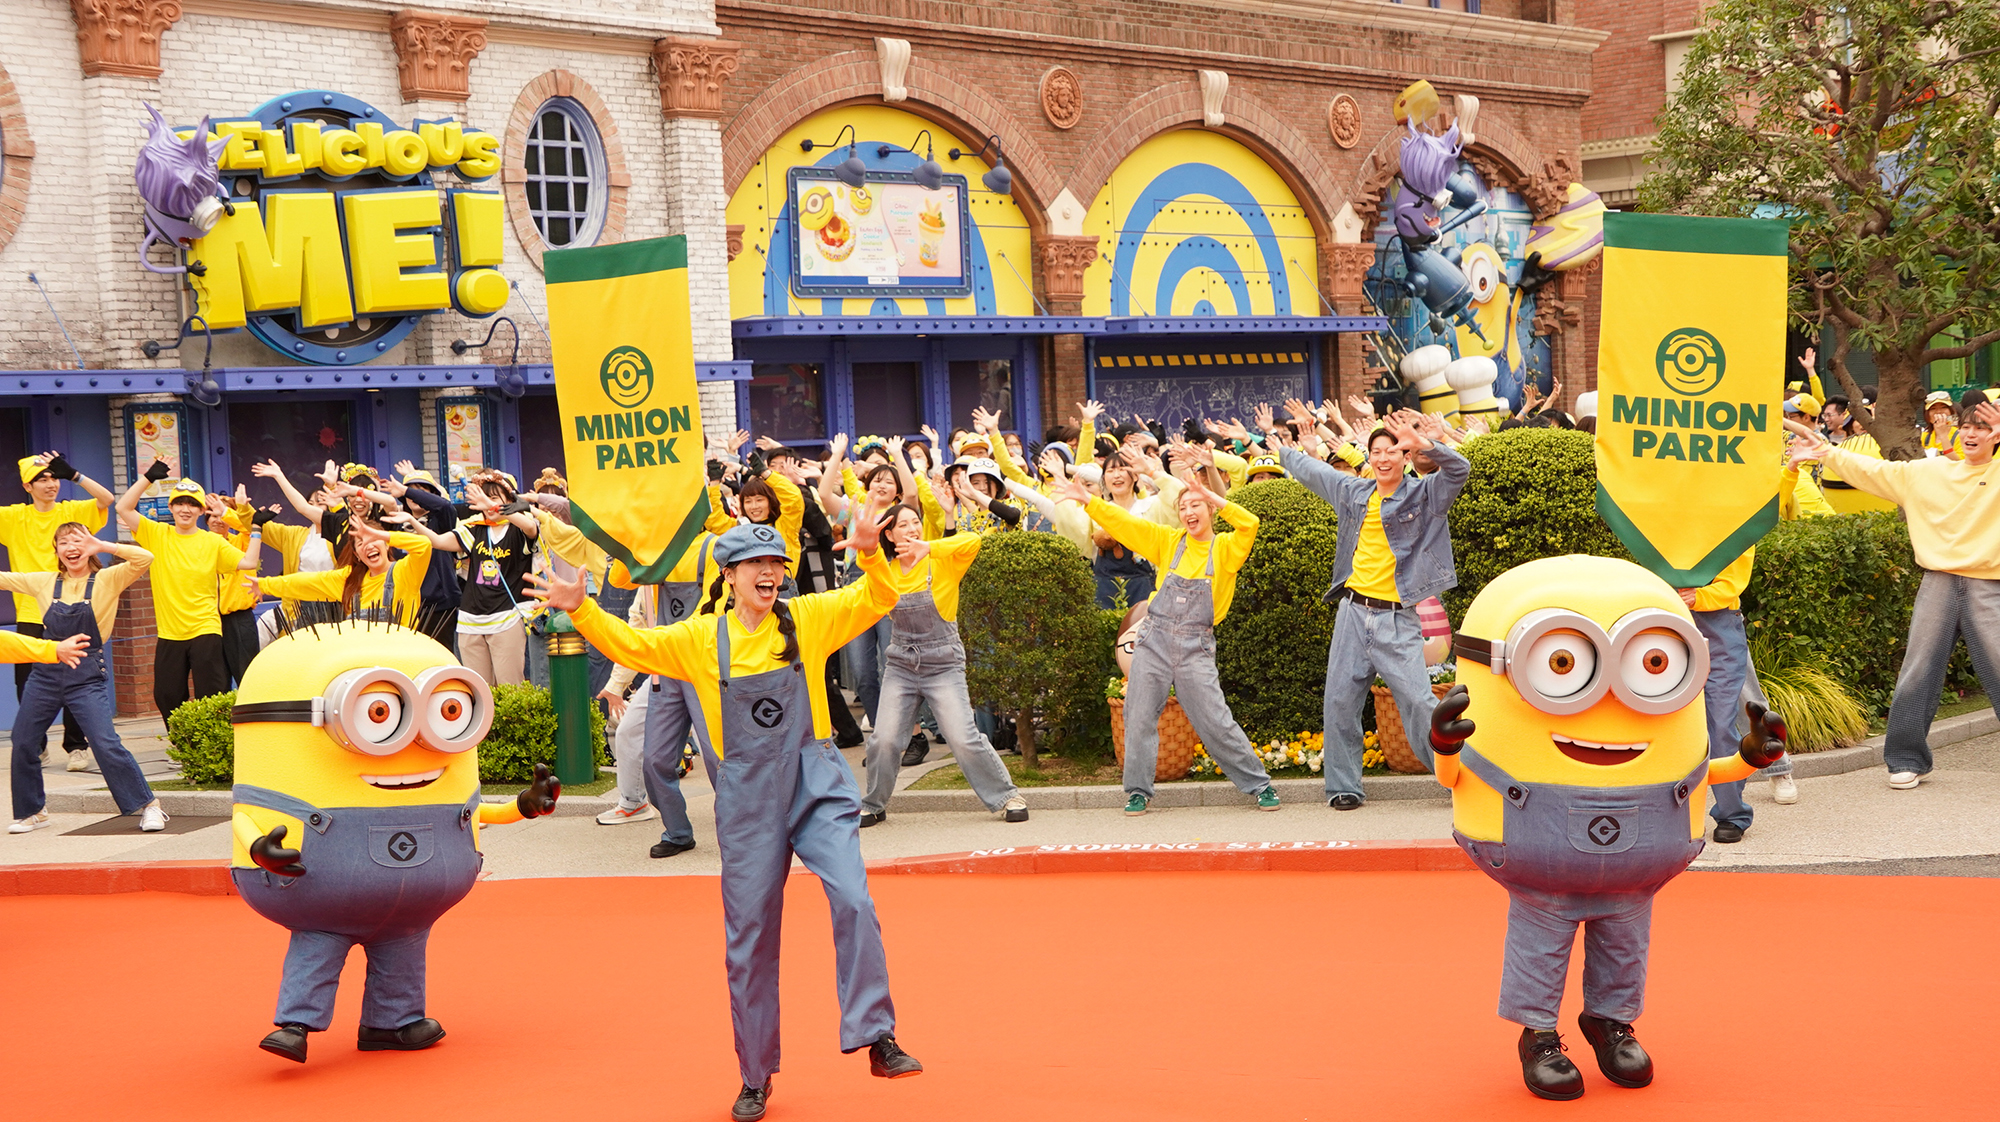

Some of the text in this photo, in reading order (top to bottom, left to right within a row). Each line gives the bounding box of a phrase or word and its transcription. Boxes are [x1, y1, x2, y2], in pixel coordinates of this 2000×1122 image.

[187, 189, 510, 332] ME!
[574, 405, 692, 442] MINION
[1612, 394, 1768, 432] MINION
[596, 437, 681, 471] PARK
[1633, 429, 1746, 465] PARK
[969, 840, 1358, 857] NO STOPPING S.F.P.D.
